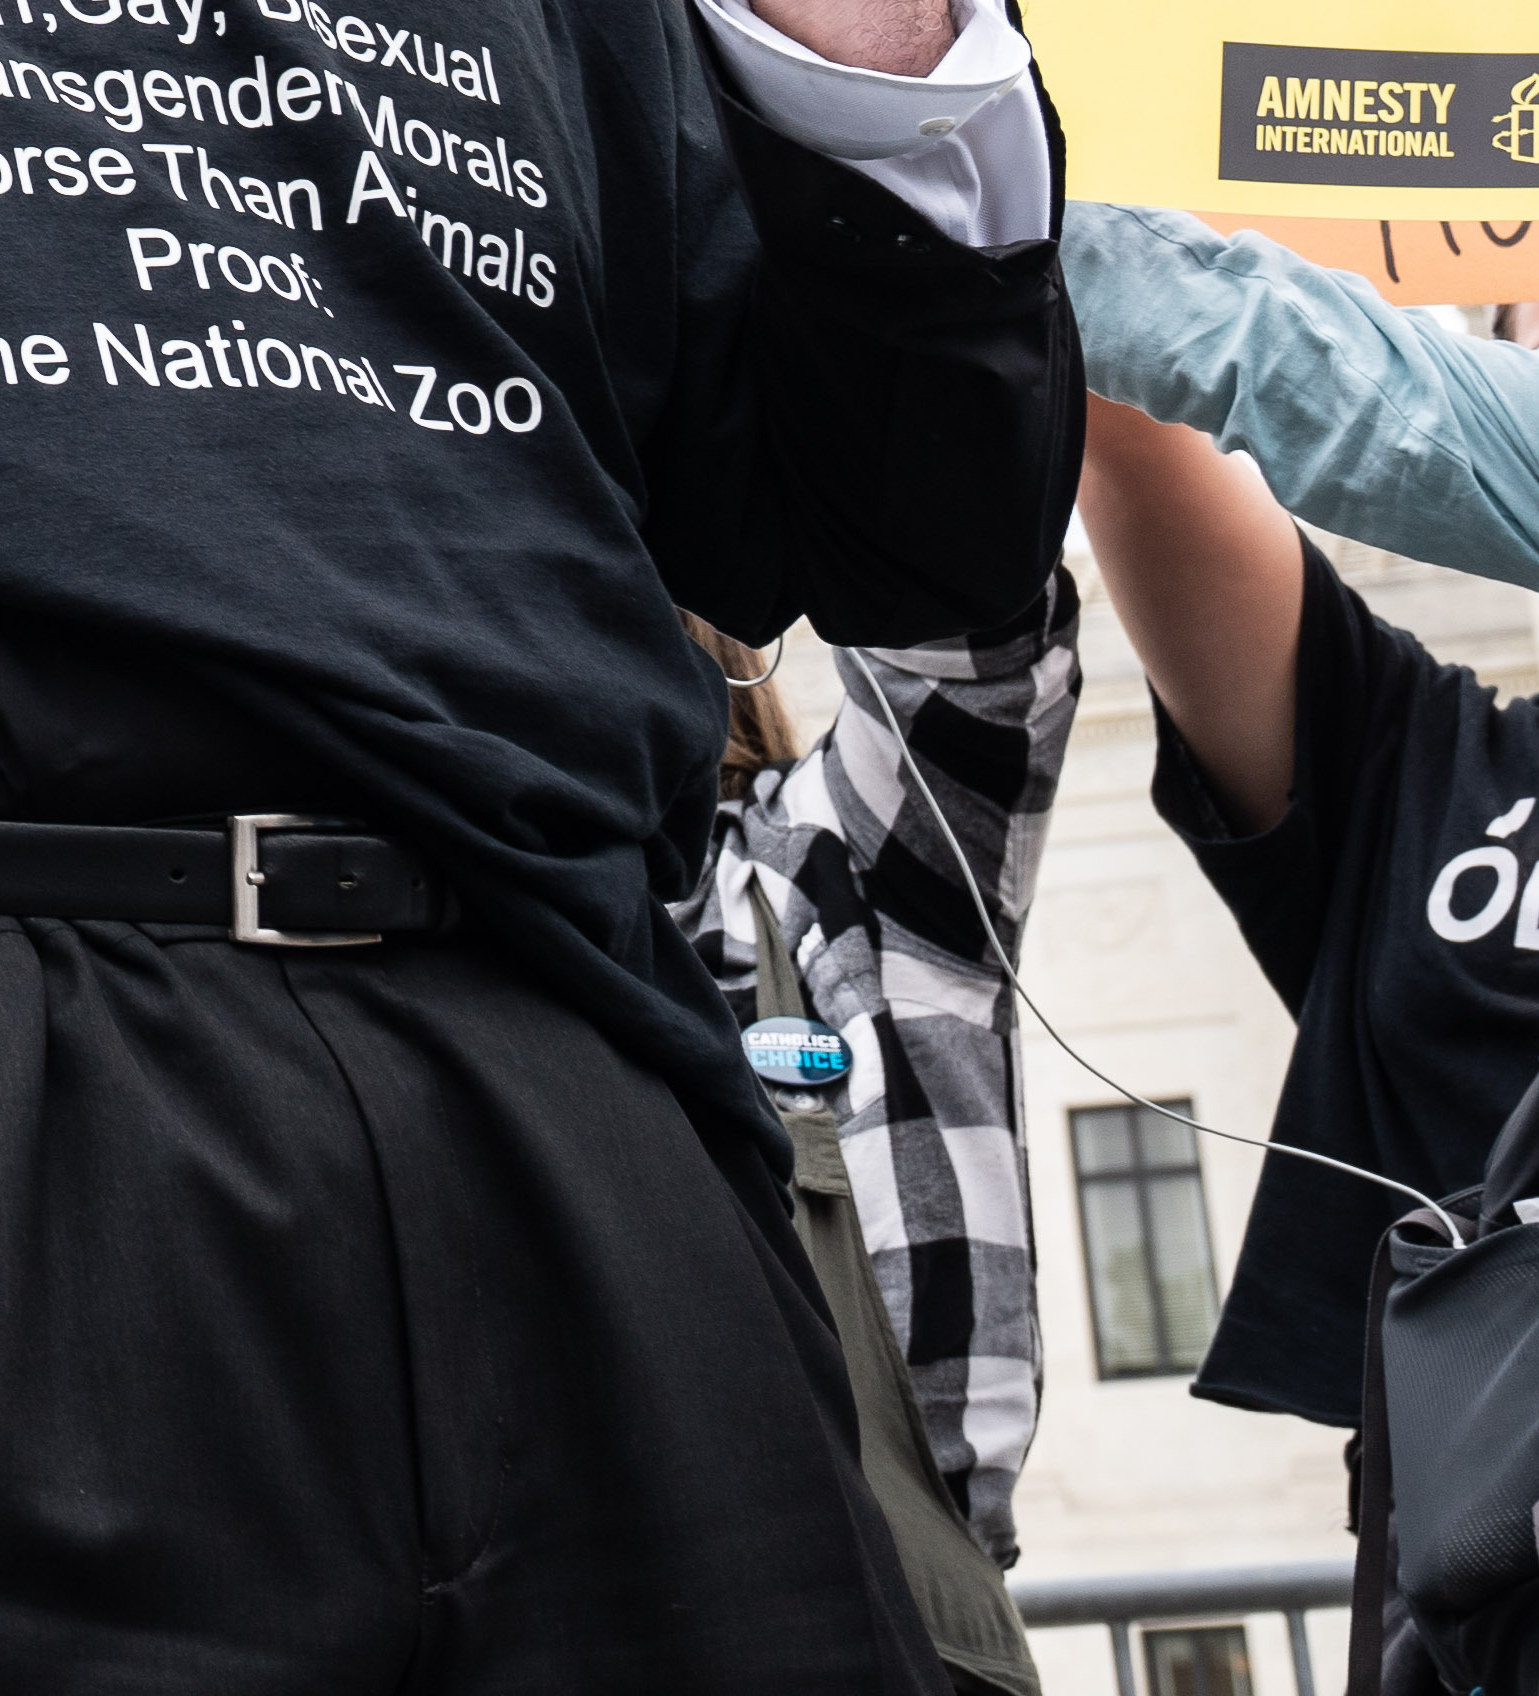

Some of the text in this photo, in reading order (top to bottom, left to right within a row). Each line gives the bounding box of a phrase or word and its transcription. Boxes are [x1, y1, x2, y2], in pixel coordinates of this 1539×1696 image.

[1255, 75, 1456, 124] AMNESTY
[1255, 124, 1455, 158] INTERNATIONAL
[141, 143, 323, 231] Than
[125, 227, 335, 318] Proof:
[92, 319, 396, 413] National
[392, 364, 542, 435] Zoo
[747, 1032, 841, 1049] CATHOLICS
[750, 1050, 845, 1070] CHOICE
